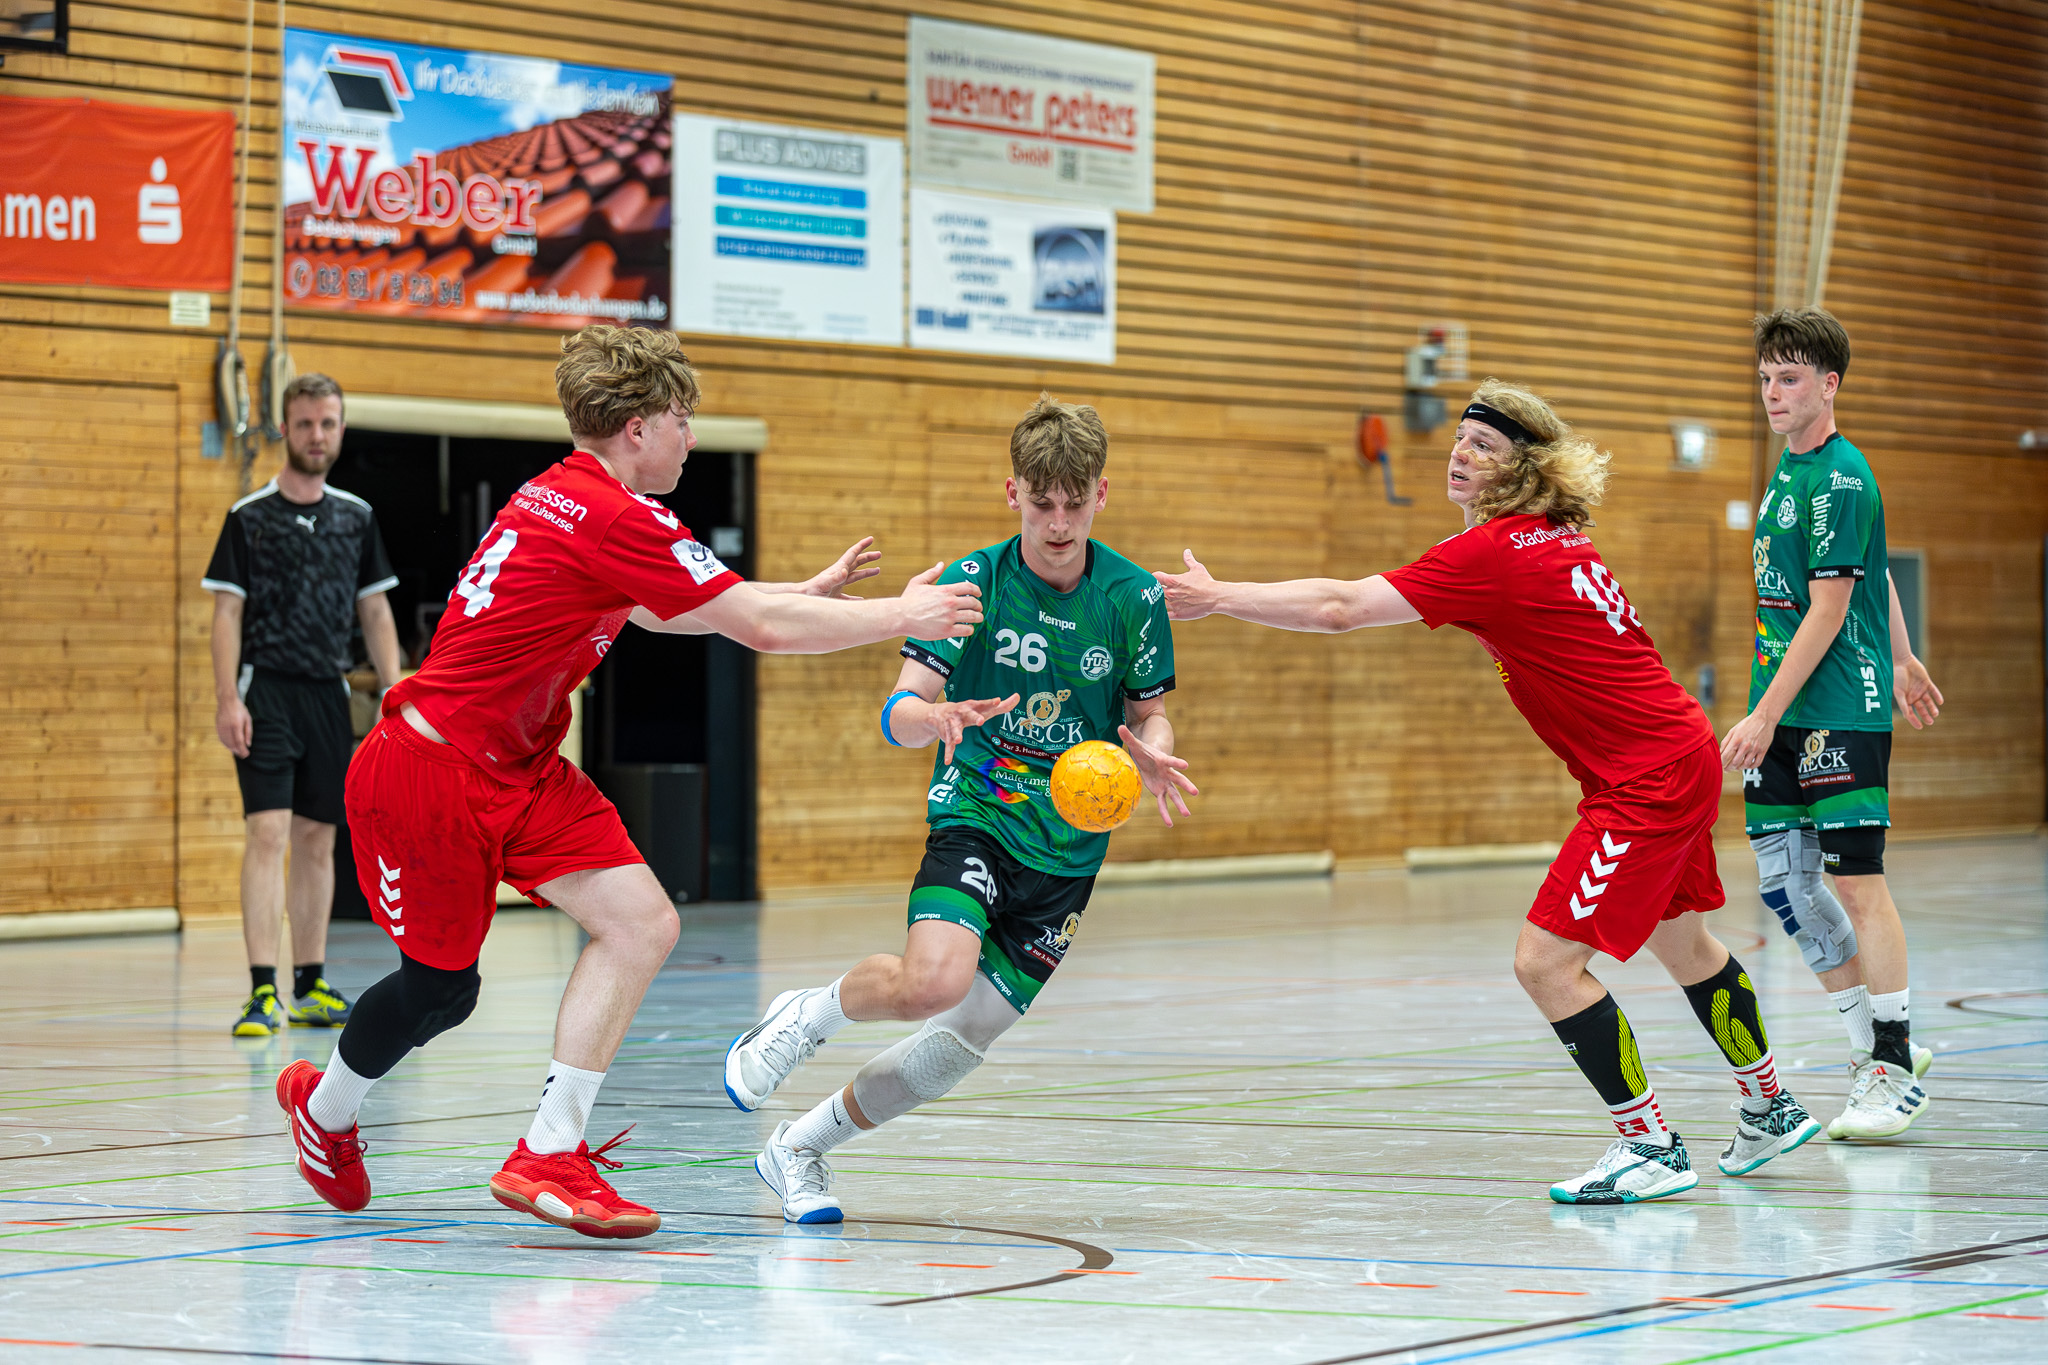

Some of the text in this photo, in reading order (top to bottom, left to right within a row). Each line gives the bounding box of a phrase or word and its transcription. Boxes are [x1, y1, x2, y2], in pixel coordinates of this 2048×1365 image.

[718, 131, 780, 164] PLUS
[297, 138, 544, 236] Weber
[1759, 486, 1776, 521] 4
[1815, 570, 1840, 578] Kempa
[1039, 610, 1077, 631] Kempa
[995, 628, 1049, 673] 26
[926, 655, 951, 676] Kempa
[1085, 656, 1110, 669] TUS
[1140, 685, 1164, 699] Kempa
[1000, 711, 1084, 744] MECK
[995, 770, 1050, 787] Malermei
[1762, 821, 1786, 830] Kempa
[1823, 821, 1845, 830] Kempa
[914, 912, 941, 921] Kempa
[959, 917, 982, 937] Kempa
[991, 970, 1013, 997] Kempa
